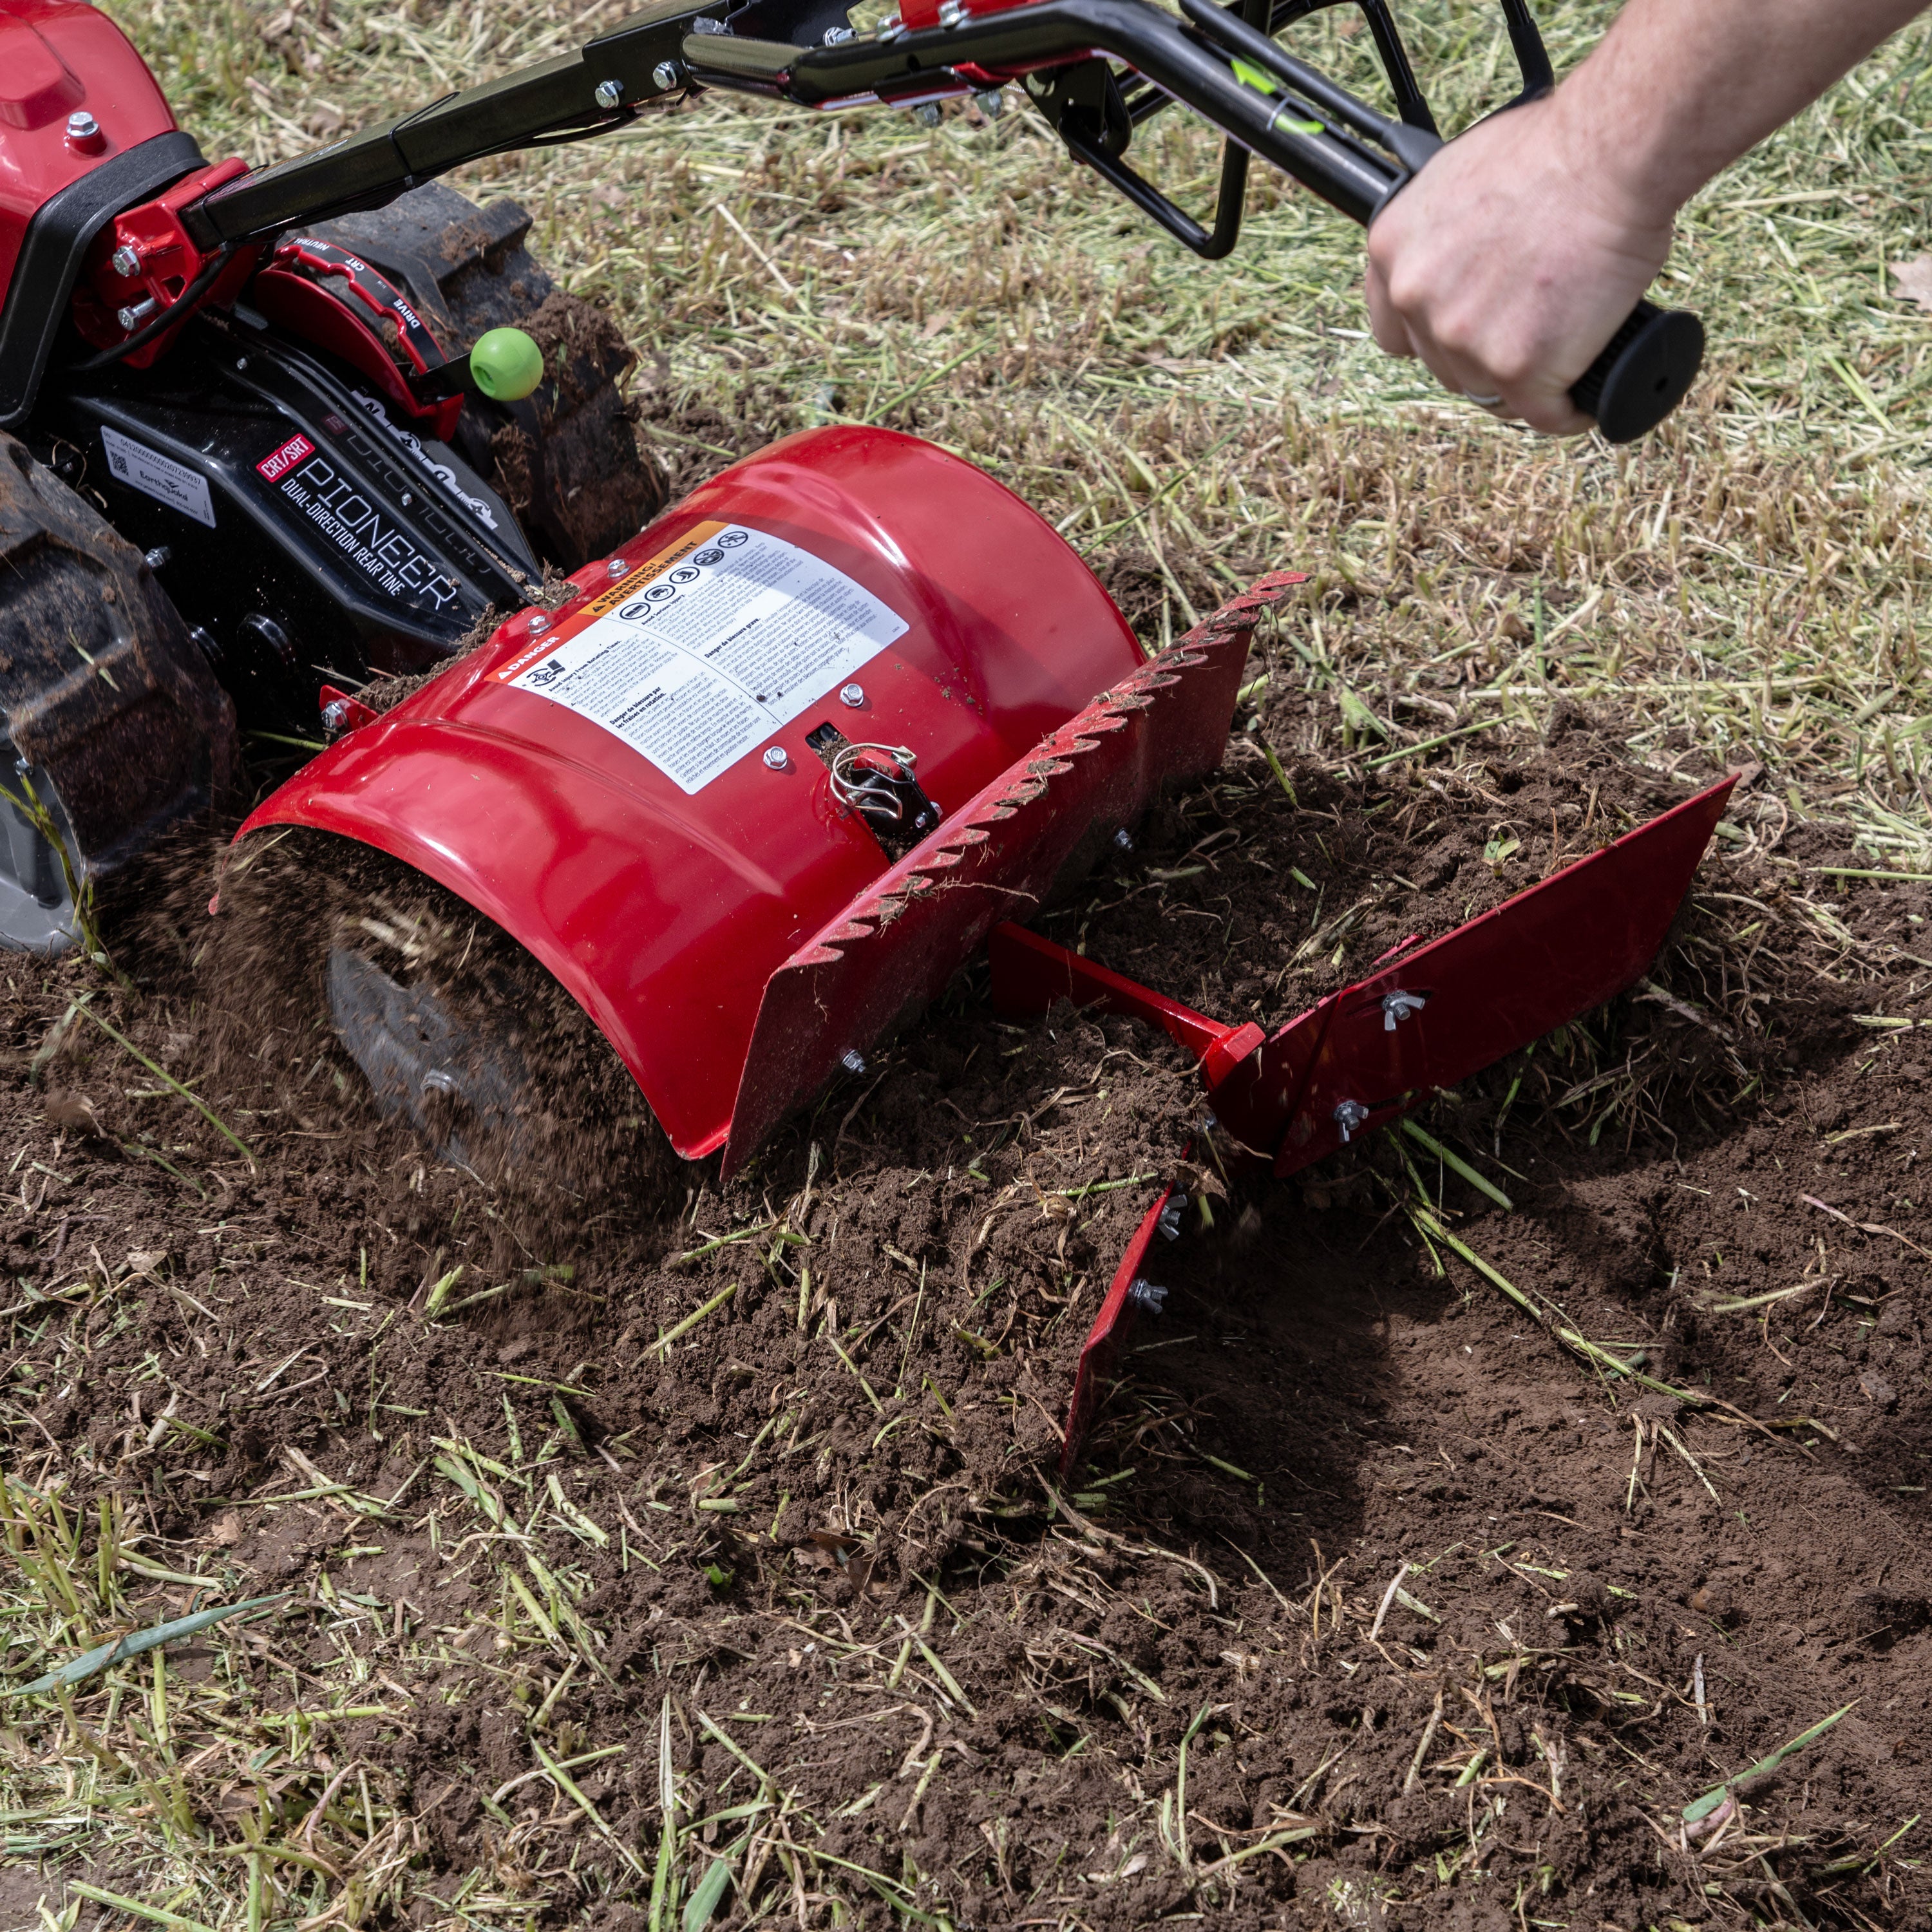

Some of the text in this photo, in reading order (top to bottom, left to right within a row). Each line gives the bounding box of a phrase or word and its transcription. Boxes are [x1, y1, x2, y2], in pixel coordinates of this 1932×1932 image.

[294, 238, 330, 251] NEUTRAL
[345, 258, 365, 272] CRT
[393, 298, 421, 329] DRIVE
[261, 437, 310, 478] CRT/SRT
[139, 470, 189, 502] Earthquake
[280, 478, 406, 597] DUAL-DIRECTION REAR TINE
[296, 457, 457, 611] PIONEER
[598, 563, 656, 604] WARNING/
[609, 541, 698, 606] AVERTISSEMENT
[508, 636, 560, 672] DANGER
[703, 644, 723, 658] Danger
[725, 627, 746, 642] blessure
[744, 617, 761, 629] grave.
[608, 710, 629, 725] Danger
[631, 692, 654, 708] blessure
[651, 687, 661, 696] par
[621, 710, 640, 724] fraises
[644, 692, 667, 708] rotation.
